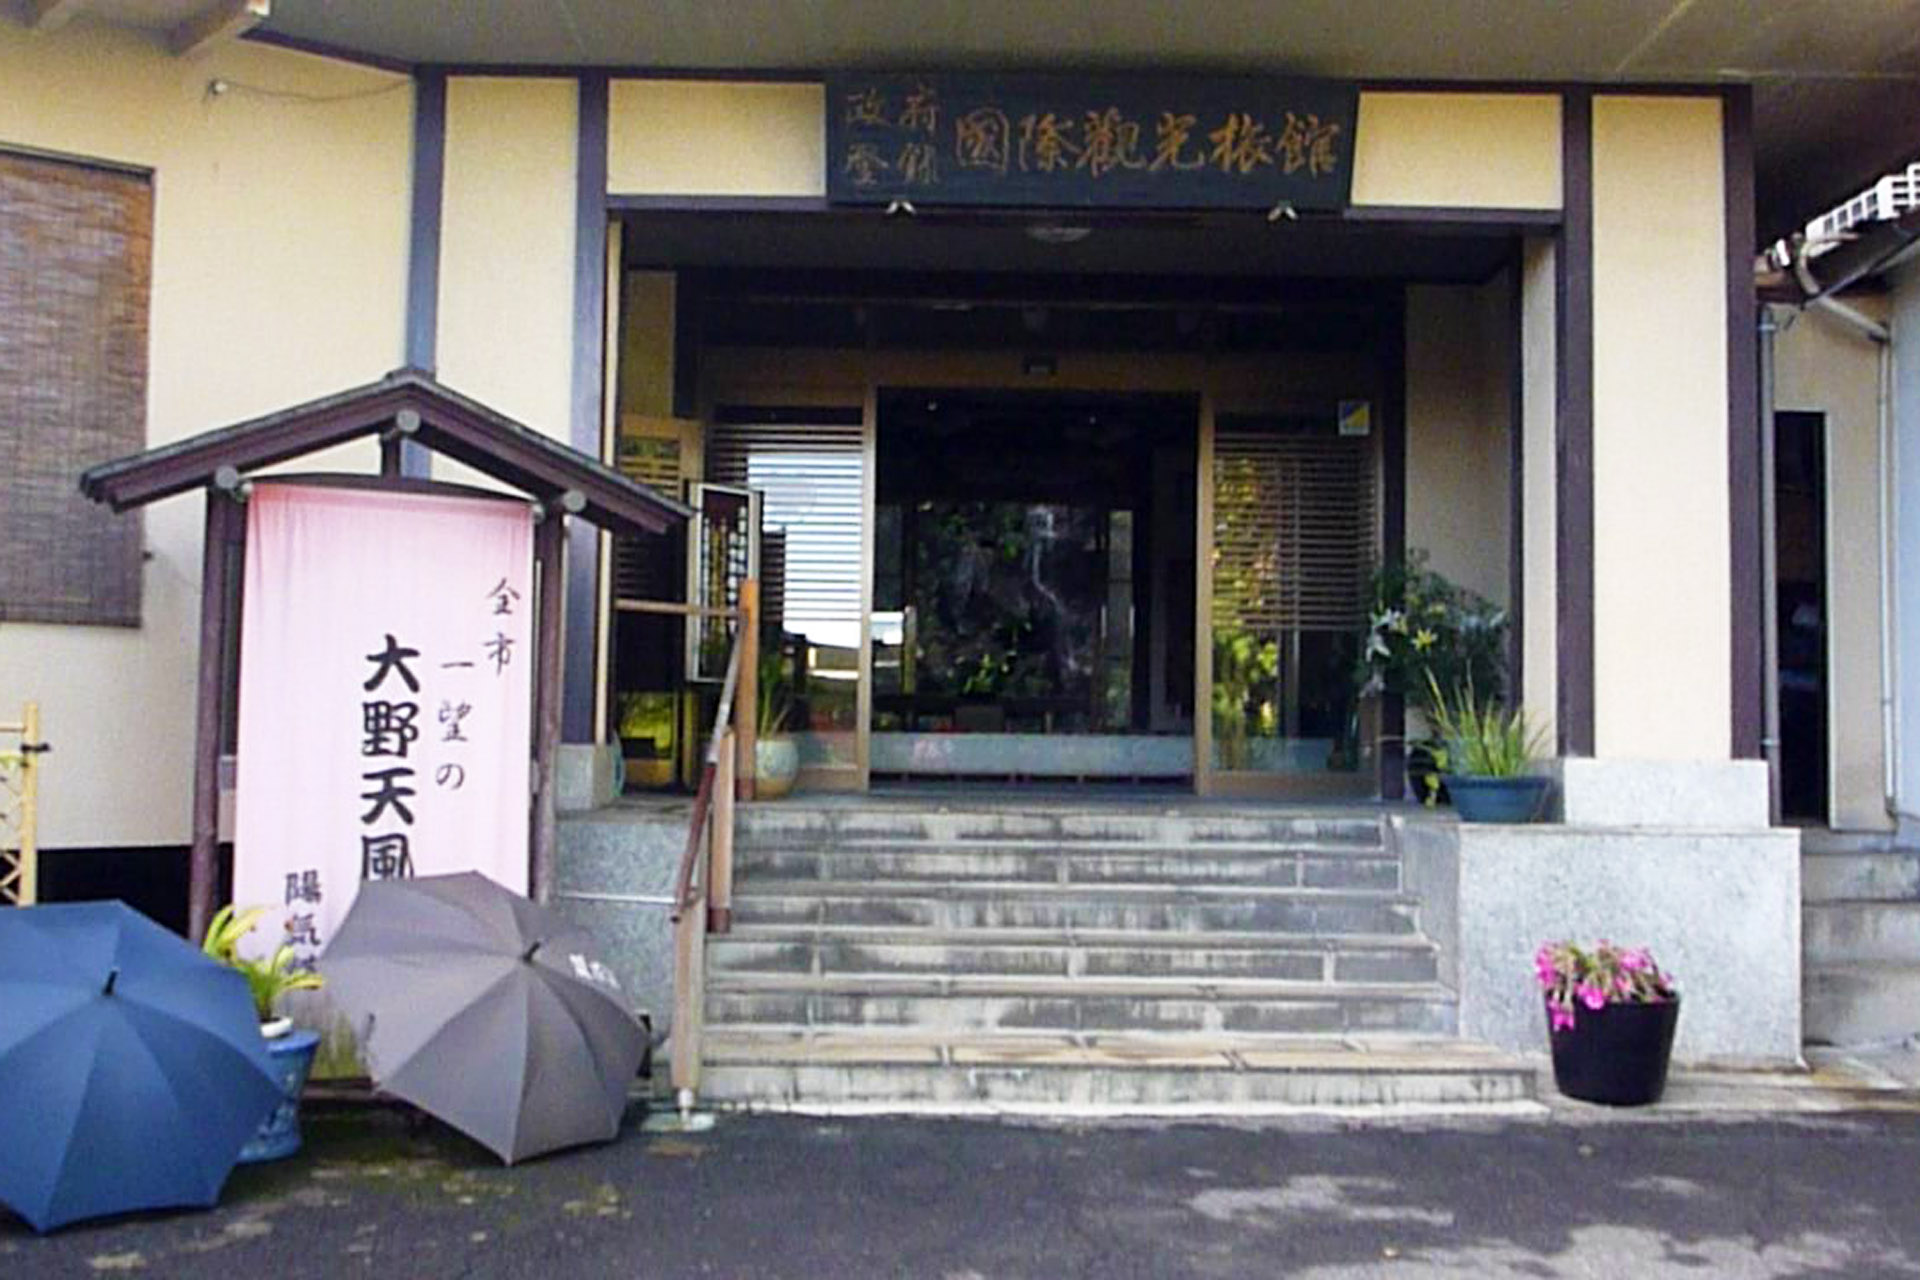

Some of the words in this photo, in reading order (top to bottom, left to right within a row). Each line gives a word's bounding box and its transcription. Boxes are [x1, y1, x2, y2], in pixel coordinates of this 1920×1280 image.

[483, 576, 521, 677] 全市
[435, 659, 475, 791] 一望の
